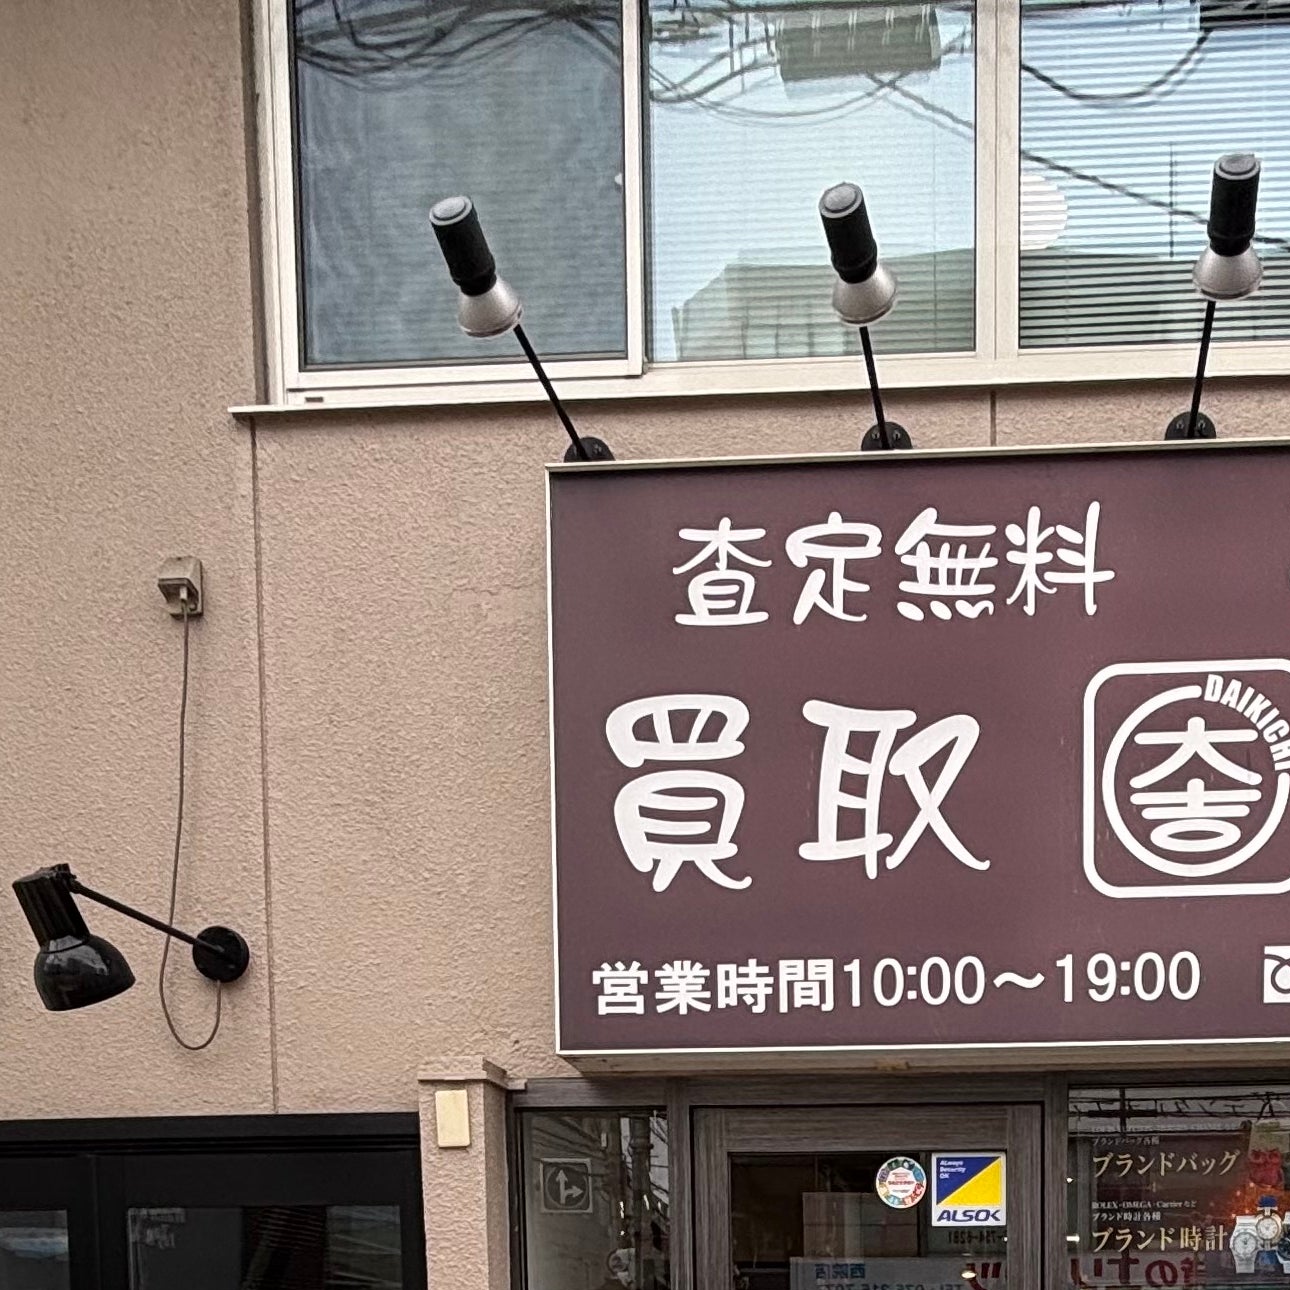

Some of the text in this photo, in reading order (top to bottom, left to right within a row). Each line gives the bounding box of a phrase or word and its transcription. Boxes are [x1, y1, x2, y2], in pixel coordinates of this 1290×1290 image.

[672, 500, 1116, 626] 査定無料
[605, 694, 991, 893] 買取
[1092, 1150, 1241, 1178] ブランドバッグ
[936, 1209, 1001, 1222] ALSOK
[1092, 1224, 1229, 1252] ブランド時計
